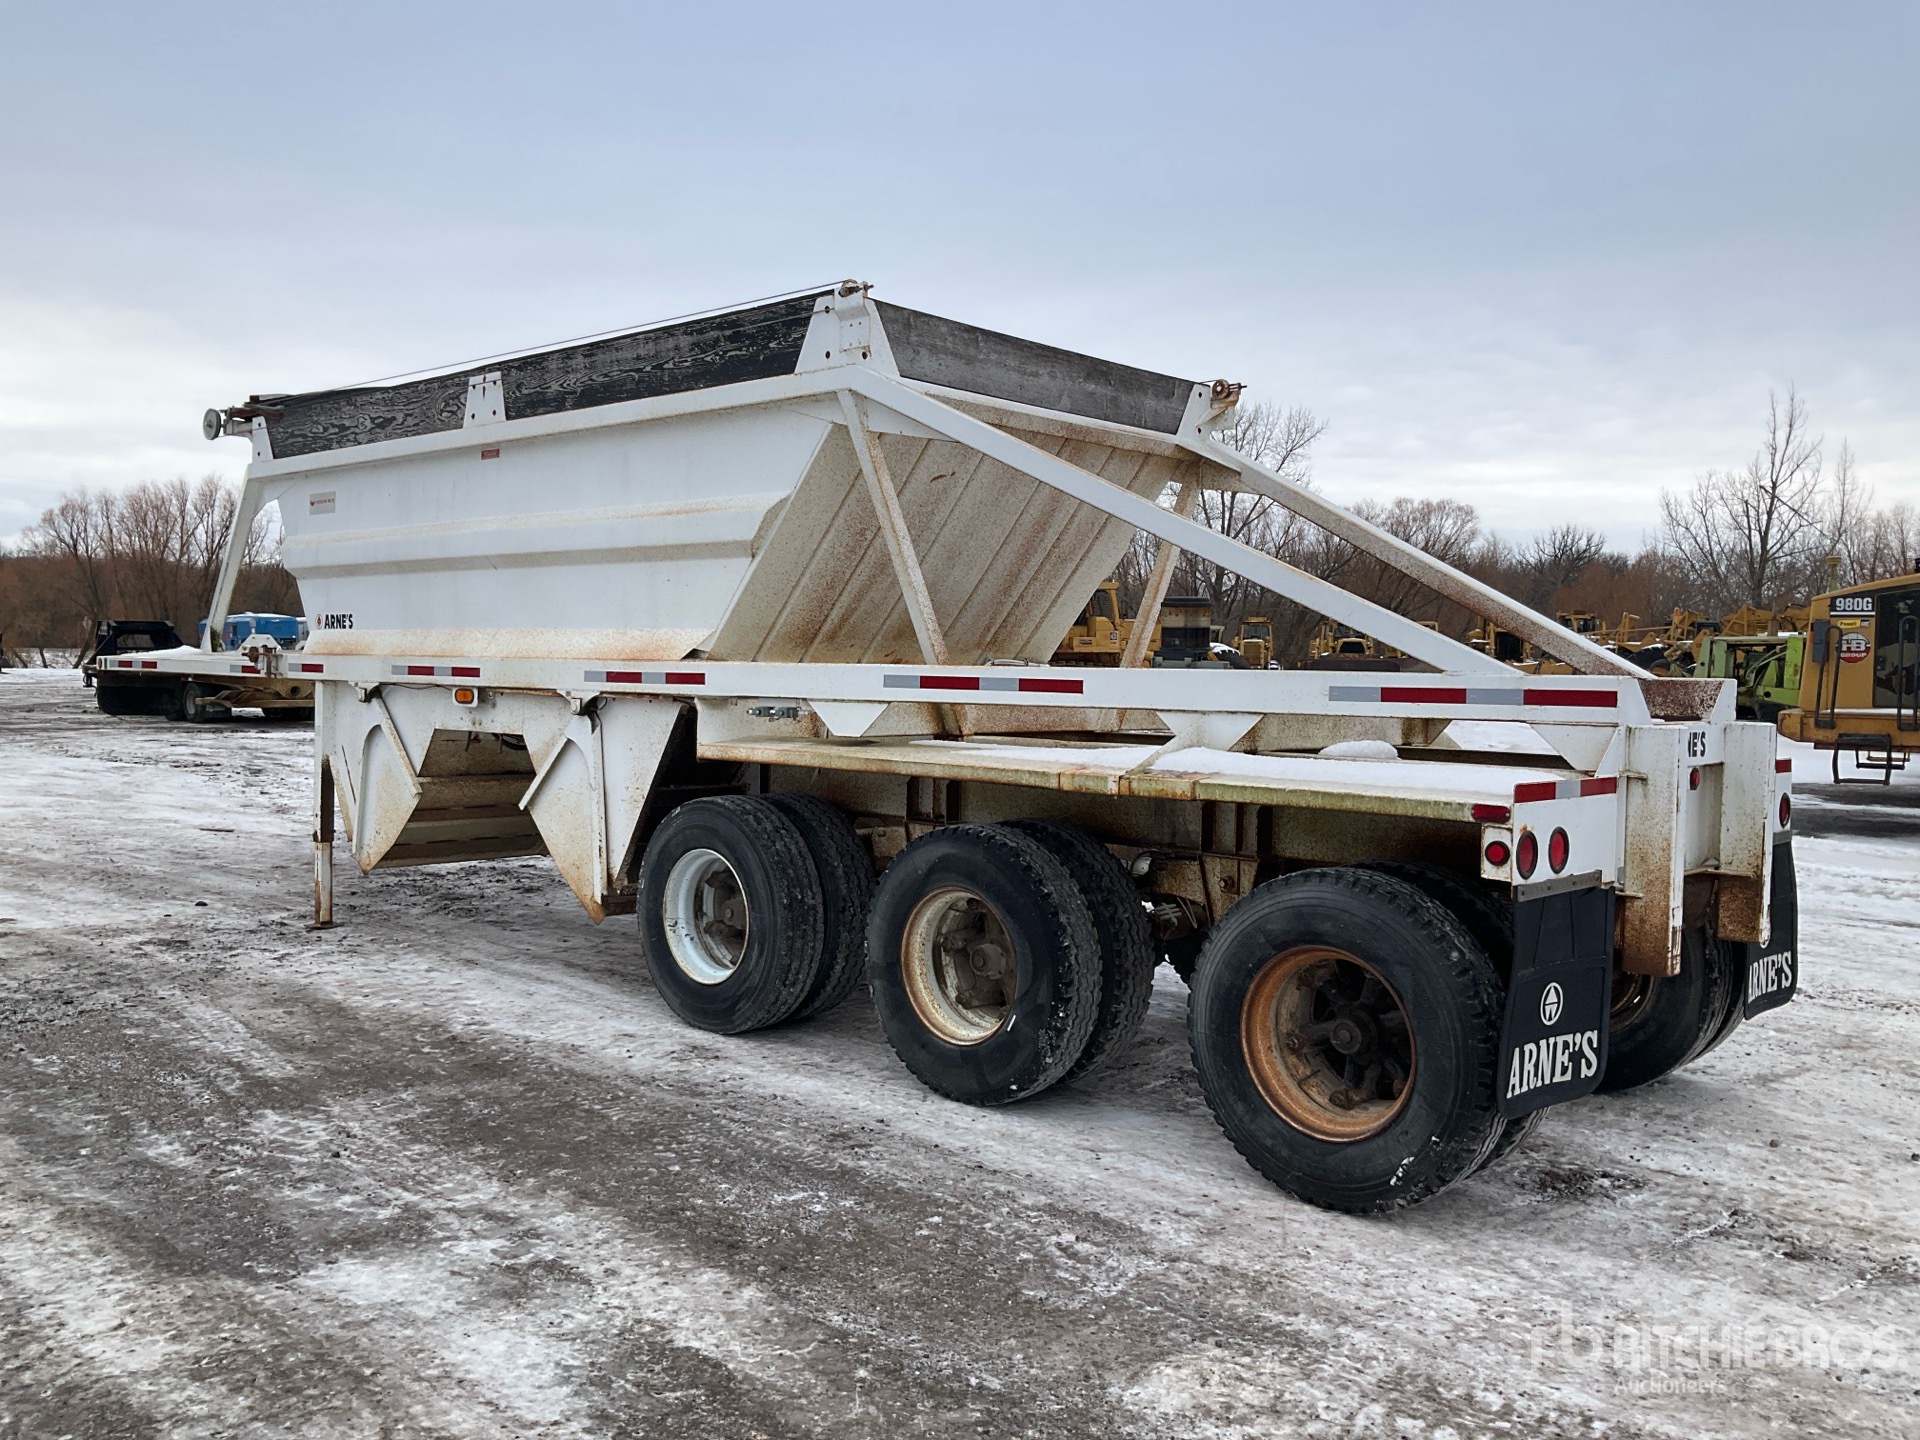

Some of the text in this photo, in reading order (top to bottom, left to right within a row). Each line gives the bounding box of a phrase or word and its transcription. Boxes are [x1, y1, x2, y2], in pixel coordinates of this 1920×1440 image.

[324, 613, 353, 630] ARNE'S
[1835, 597, 1873, 611] 980G
[1747, 950, 1793, 1004] ARNE'S
[1506, 1029, 1599, 1099] ARNE'S
